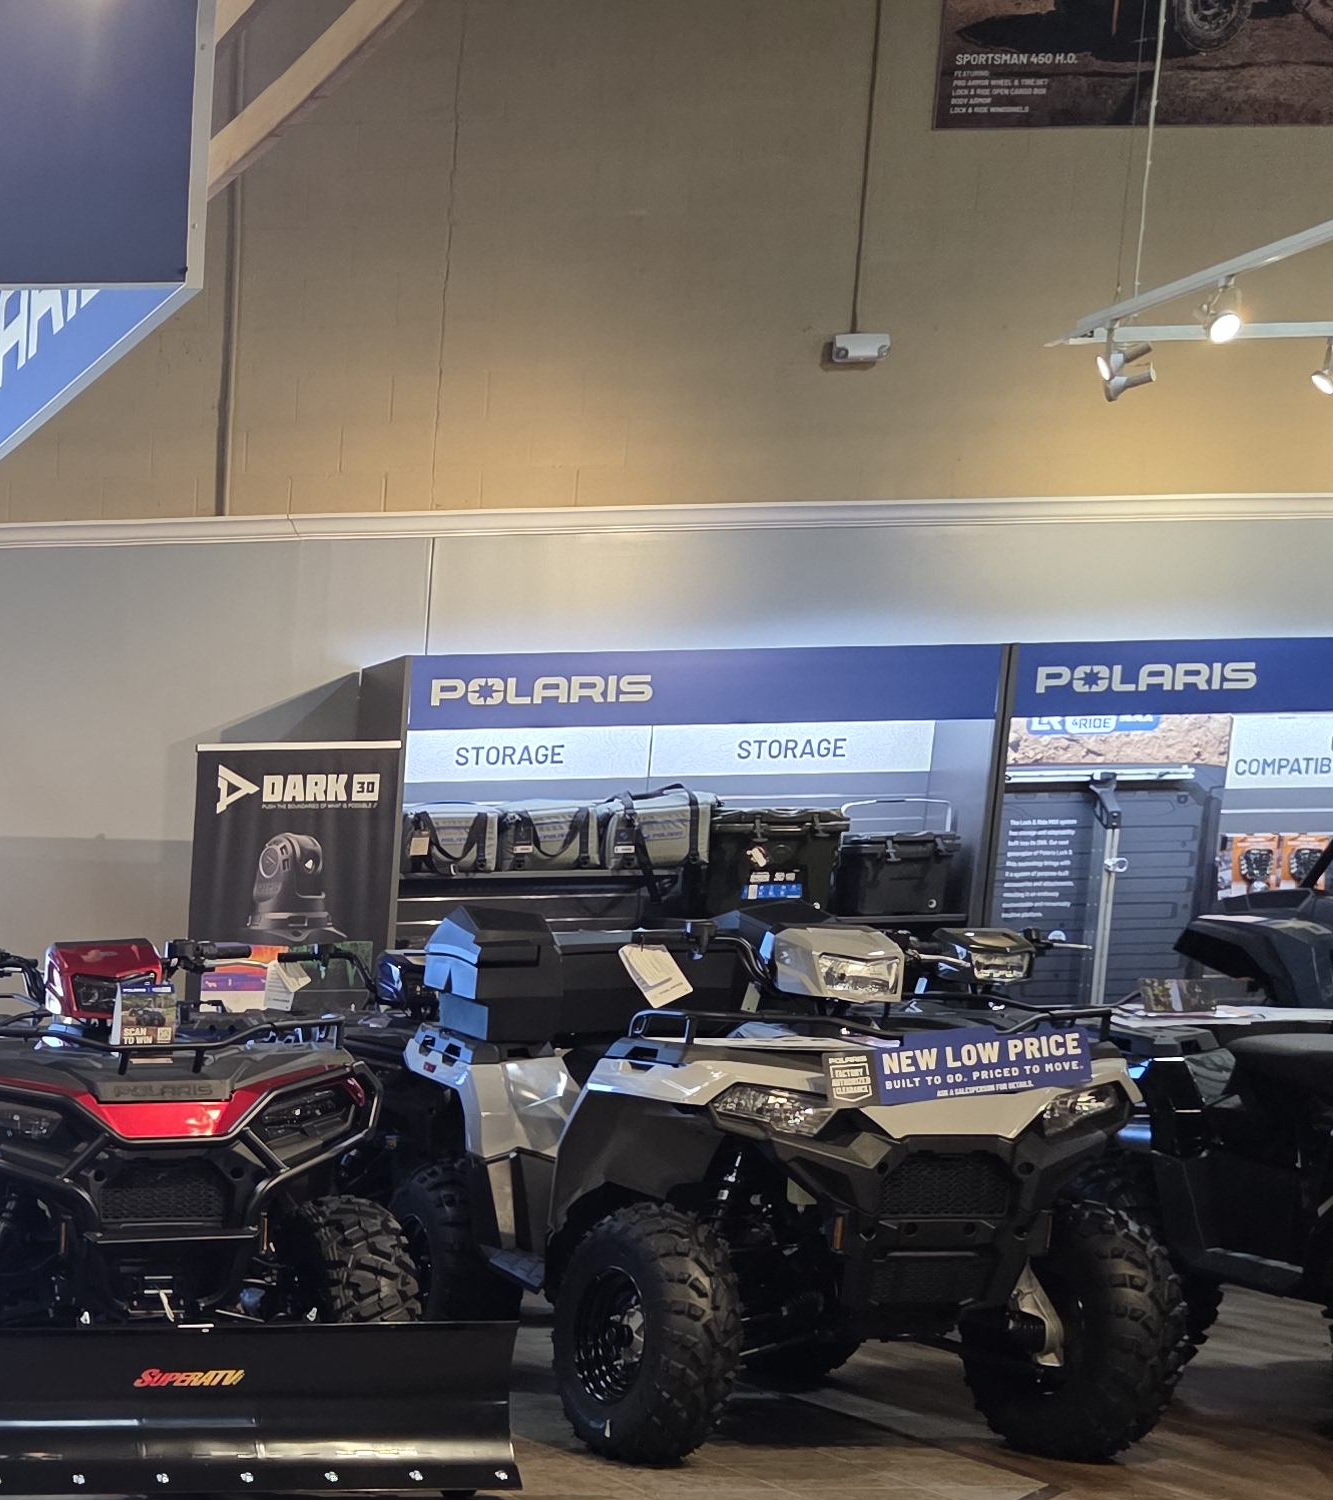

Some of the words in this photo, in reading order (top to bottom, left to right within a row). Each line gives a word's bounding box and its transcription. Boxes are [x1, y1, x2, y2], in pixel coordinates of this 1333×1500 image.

[955, 54, 1027, 65] SPORTSMAN
[1030, 53, 1053, 64] 450
[1036, 662, 1257, 694] POLARIS
[430, 675, 653, 706] POLARIS
[455, 744, 565, 768] STORAGE
[737, 738, 847, 760] STORAGE
[262, 773, 349, 803] DARK
[123, 1027, 147, 1036] SCAN
[136, 1036, 153, 1044] WIN
[882, 1047, 938, 1075] NEW
[945, 1040, 999, 1068] LOW
[1007, 1033, 1082, 1061] PRICE
[834, 1068, 863, 1078] FACTORY
[885, 1077, 921, 1090] BUILT
[925, 1075, 941, 1085] TO
[946, 1073, 968, 1084] GO.
[972, 1068, 1019, 1081] PRICED
[1024, 1065, 1040, 1075] TO
[1045, 1061, 1084, 1072] MOVE.
[114, 1084, 213, 1097] POLARIS
[836, 1085, 869, 1095] CLEARANCE
[936, 1089, 948, 1097] ASK
[955, 1085, 995, 1095] SALESPERSON
[996, 1083, 1008, 1091] FOR
